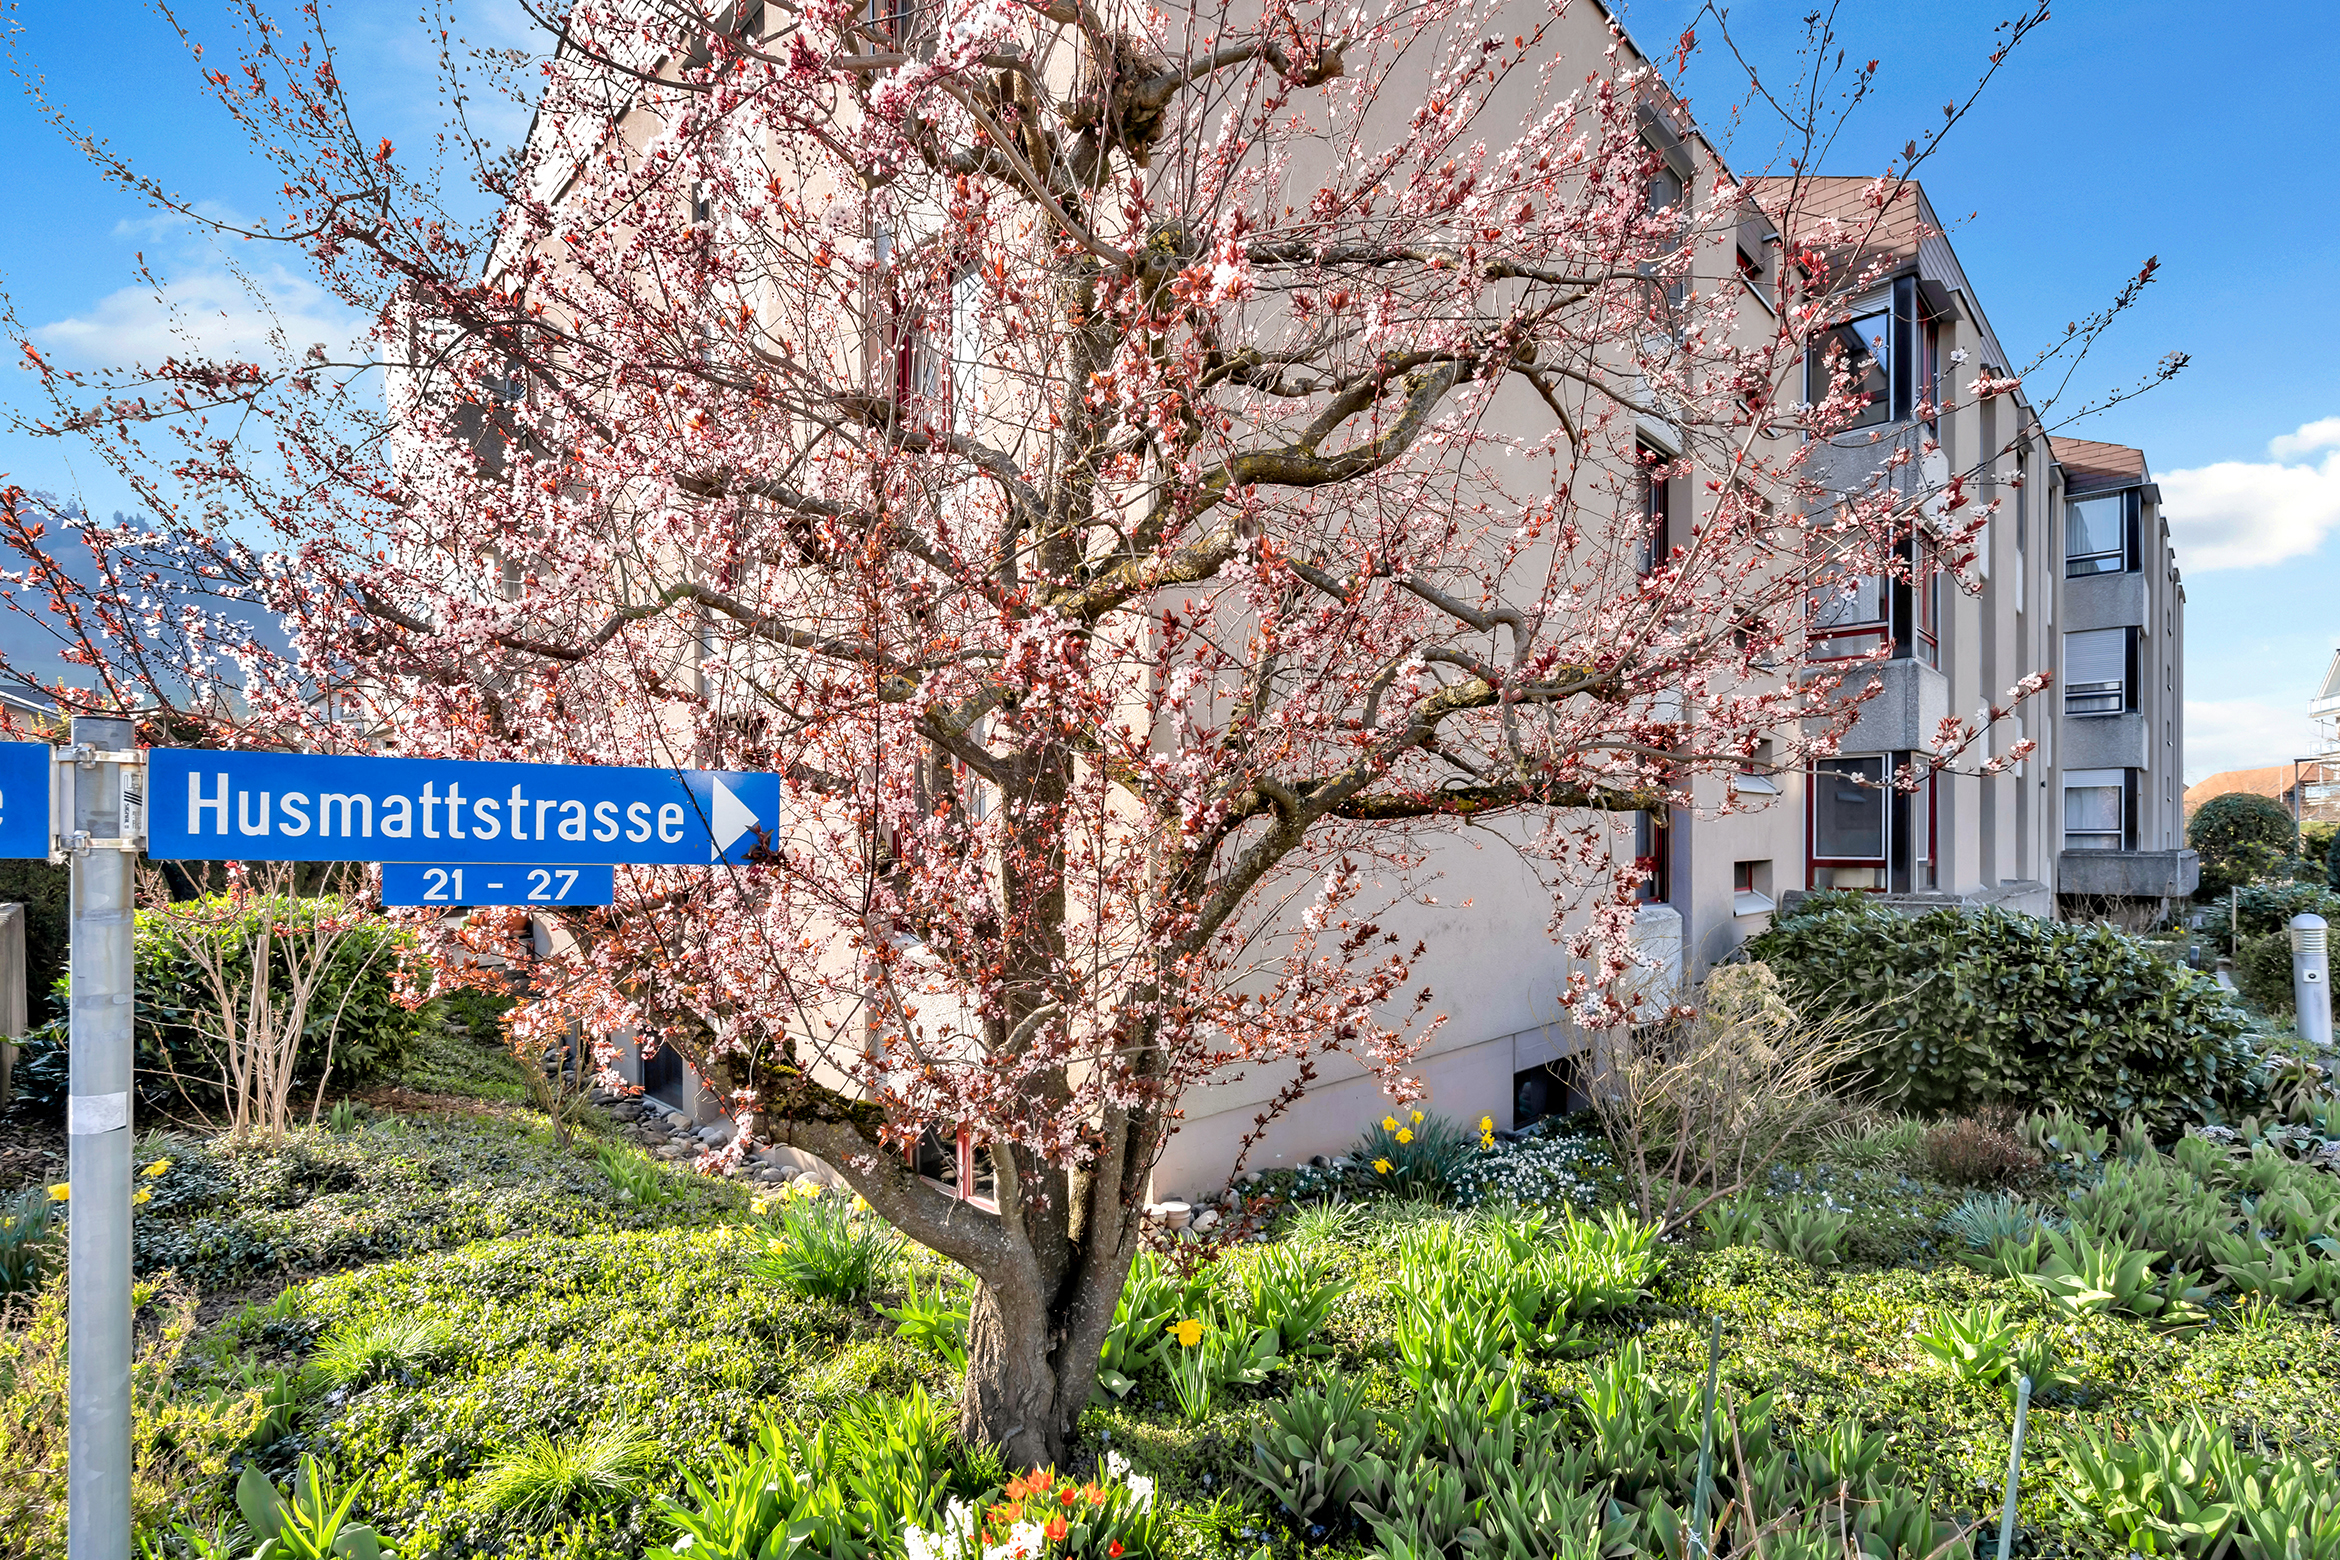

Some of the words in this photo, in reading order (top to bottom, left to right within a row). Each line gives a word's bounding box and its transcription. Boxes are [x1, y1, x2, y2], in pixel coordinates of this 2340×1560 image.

[187, 771, 685, 843] Husmattstrasse
[422, 868, 463, 900] 21
[527, 869, 579, 900] 27
